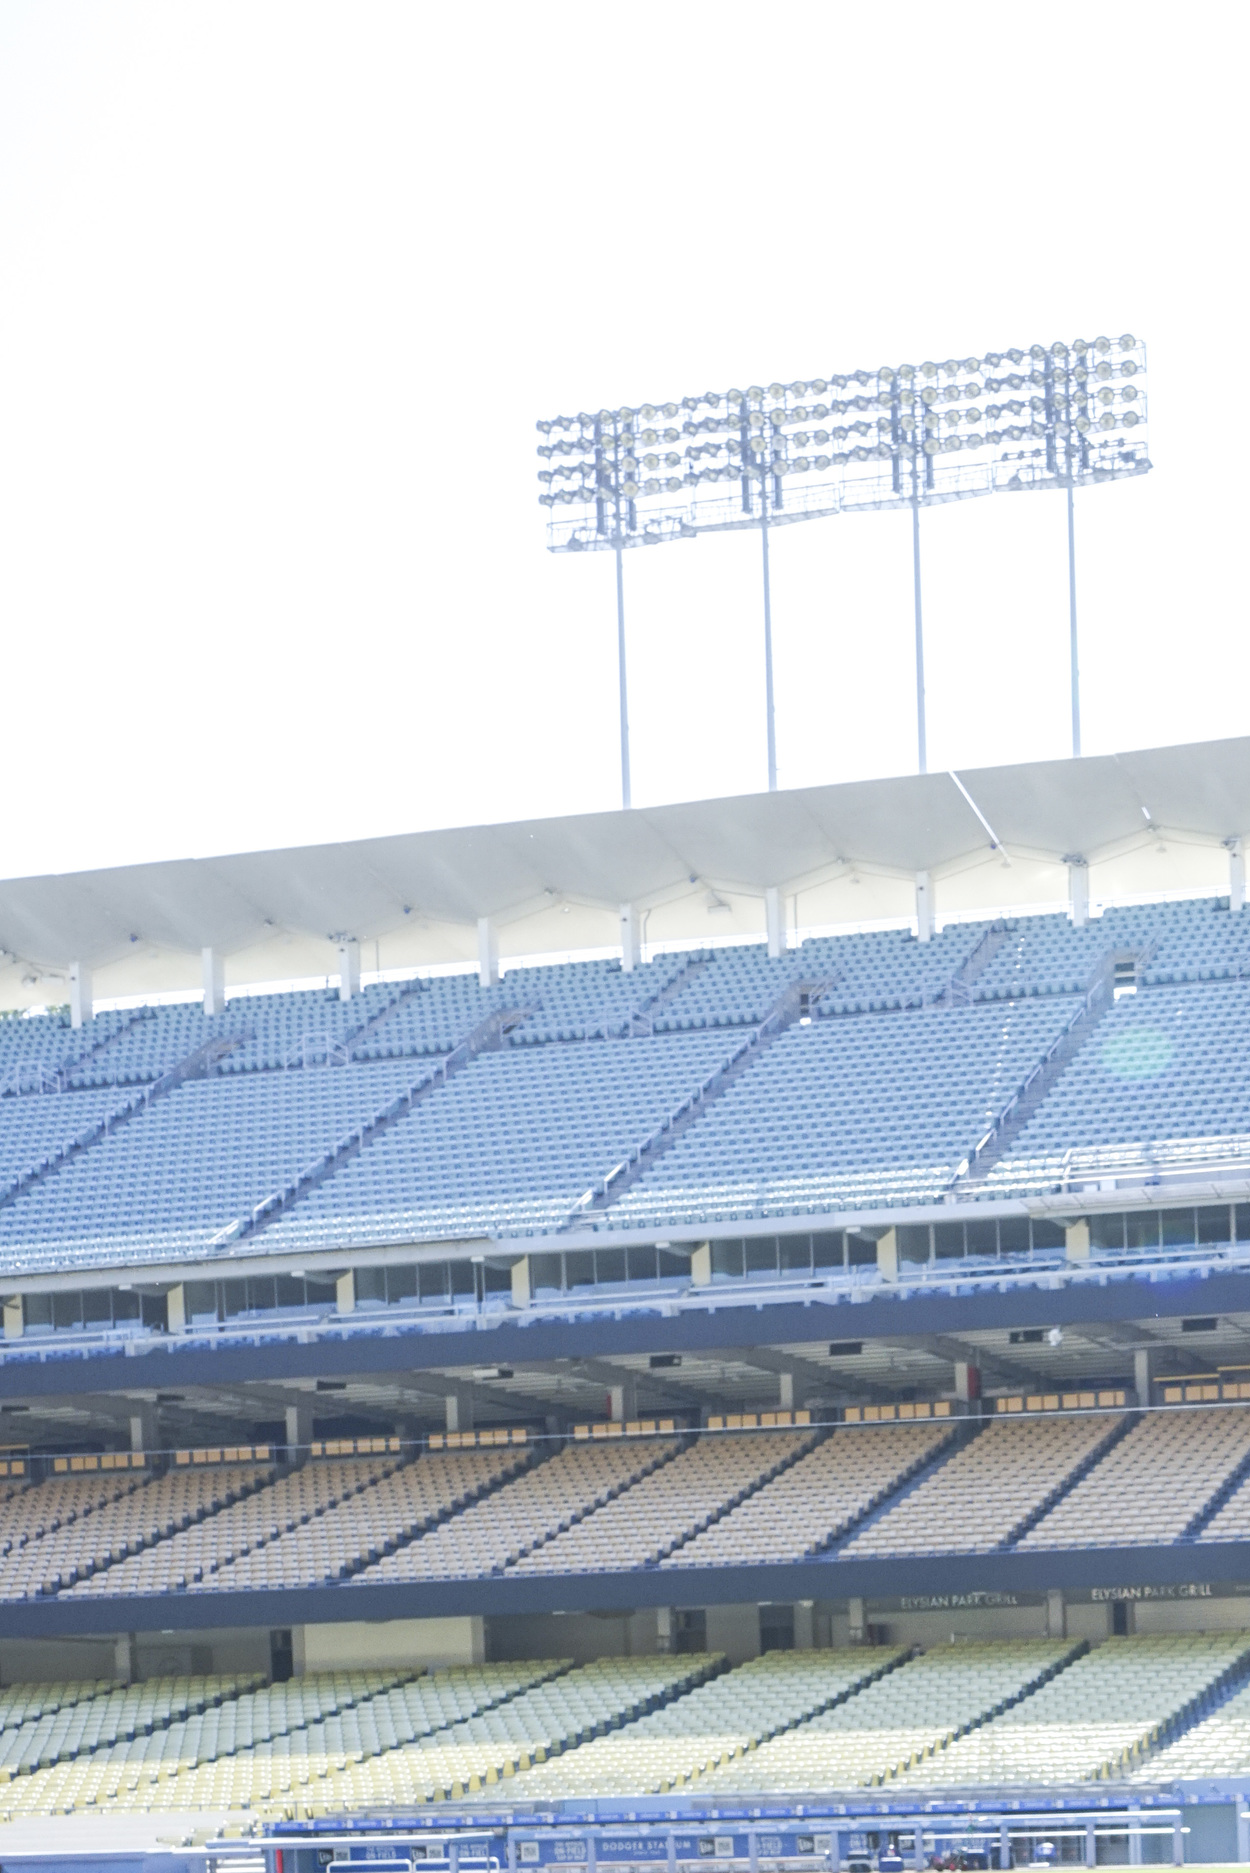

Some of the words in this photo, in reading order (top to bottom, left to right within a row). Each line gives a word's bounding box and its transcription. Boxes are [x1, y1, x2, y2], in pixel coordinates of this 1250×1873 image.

[1091, 1587, 1141, 1600] ELYSIAN
[1144, 1586, 1176, 1598] PARK
[1179, 1584, 1212, 1597] GRILL
